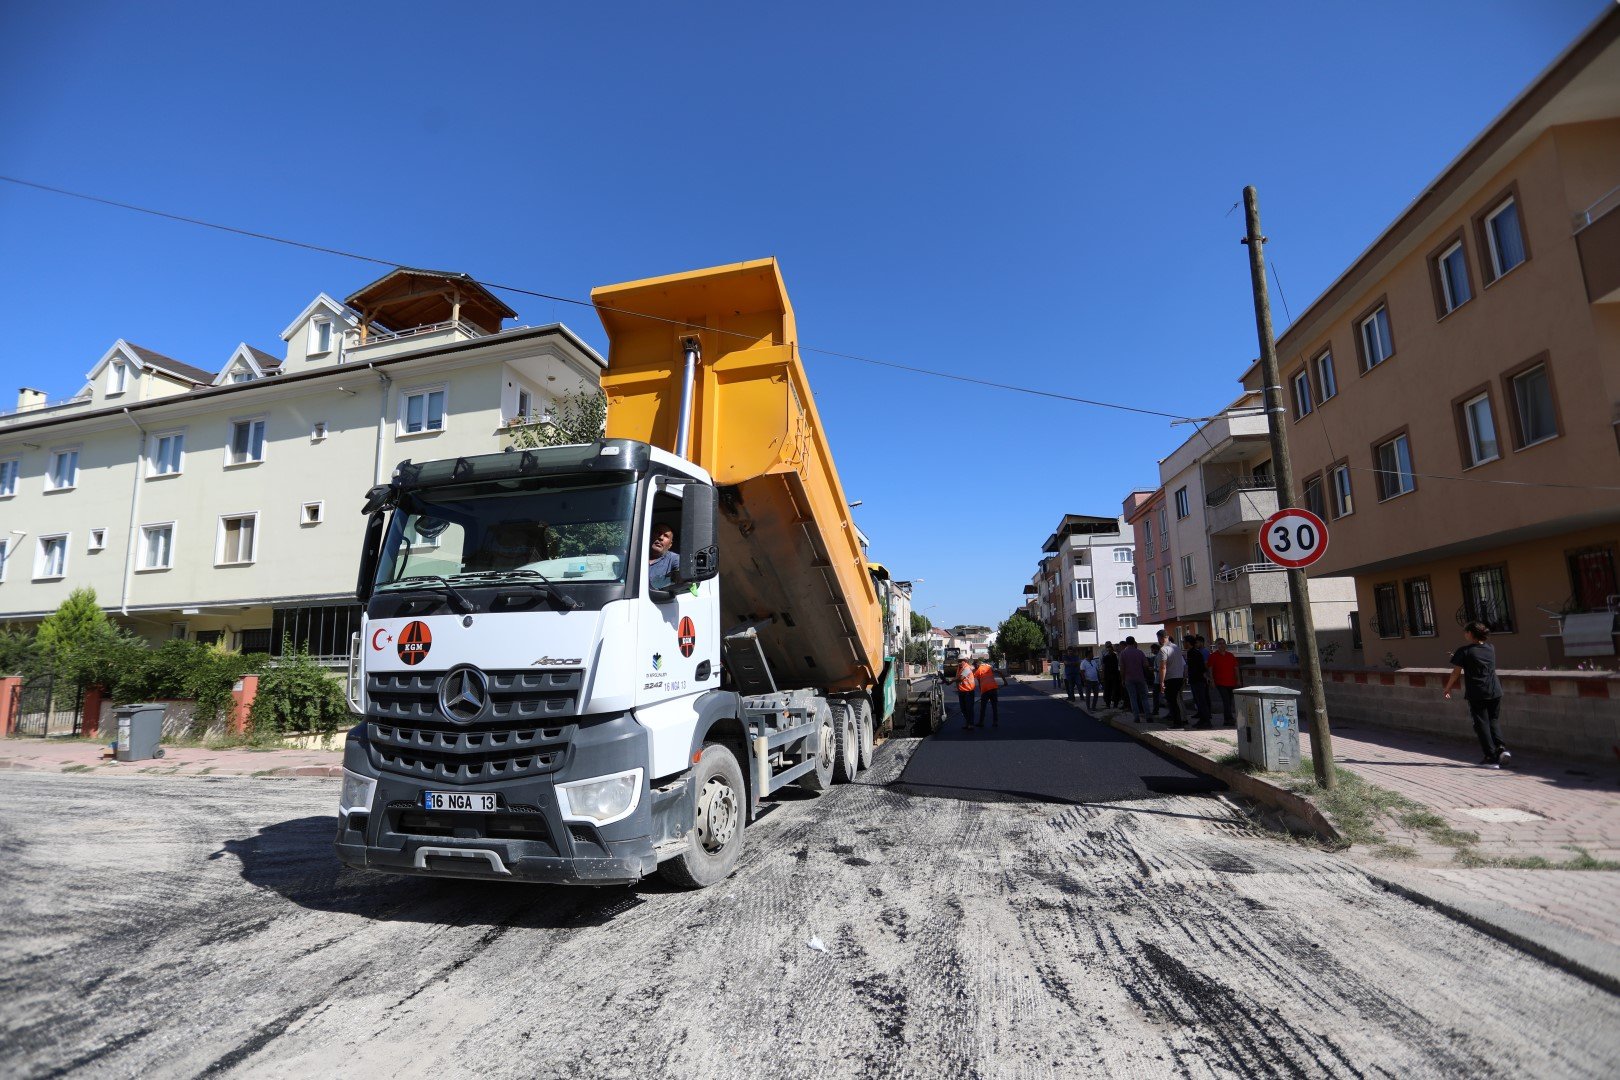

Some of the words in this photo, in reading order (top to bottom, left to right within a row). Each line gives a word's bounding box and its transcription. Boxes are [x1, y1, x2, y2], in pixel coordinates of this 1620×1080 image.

[1274, 524, 1315, 552] 30
[404, 643, 423, 651] KGM
[643, 681, 663, 690] 3242
[664, 682, 671, 692] 16
[671, 681, 680, 691] NGA
[681, 680, 687, 690] 13
[431, 794, 443, 808] 16
[448, 795, 472, 809] NGA
[481, 796, 494, 810] 13
